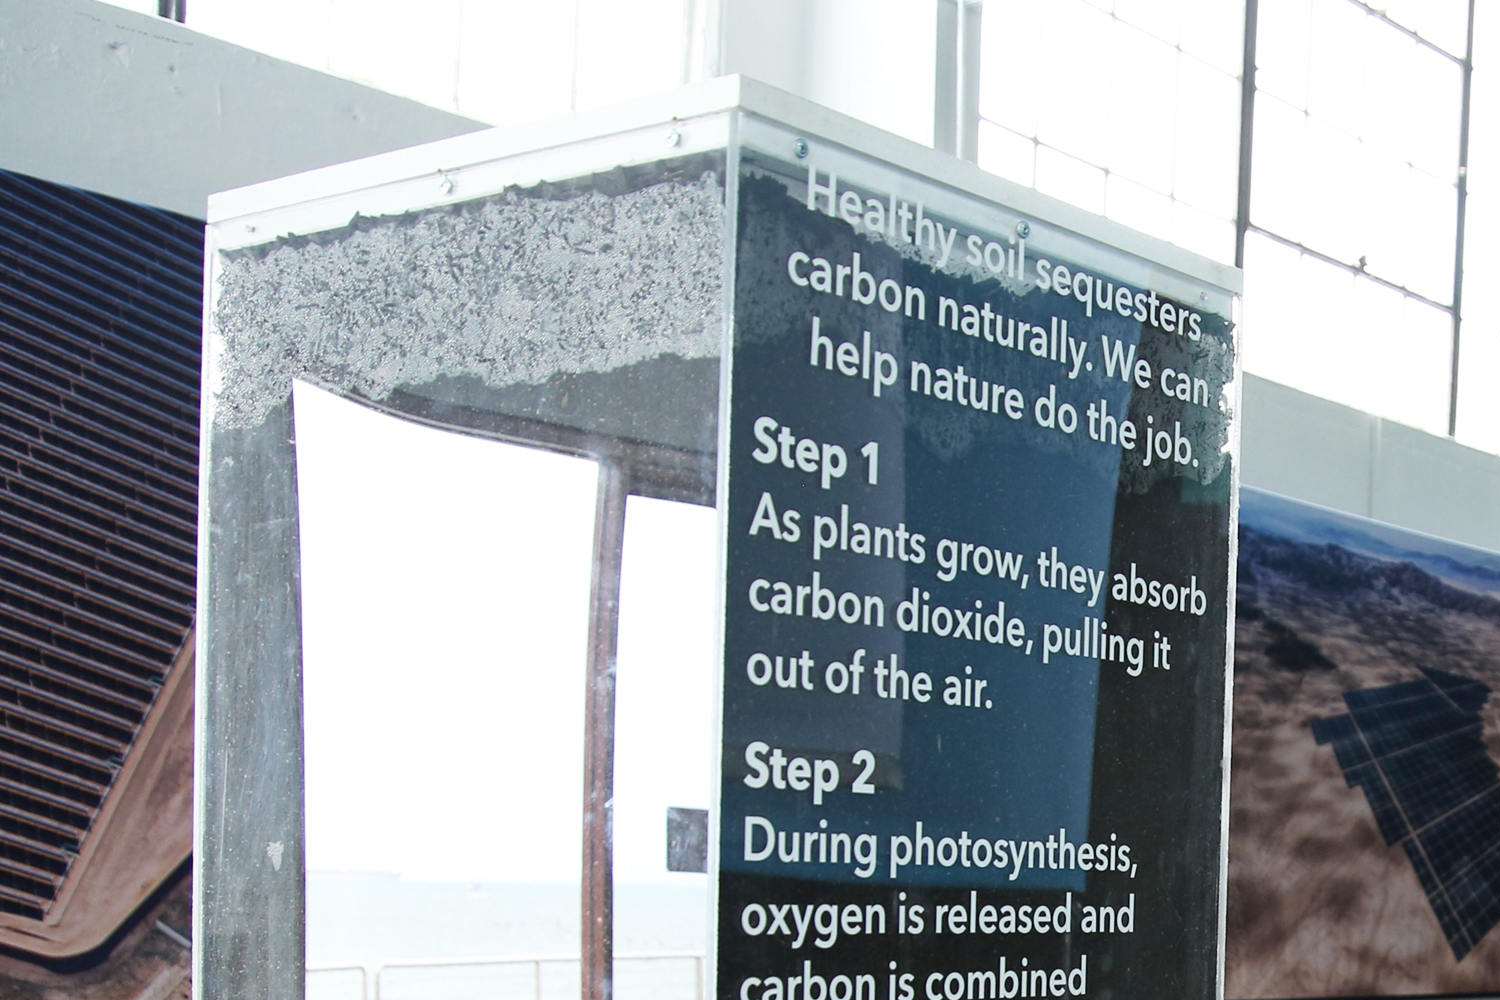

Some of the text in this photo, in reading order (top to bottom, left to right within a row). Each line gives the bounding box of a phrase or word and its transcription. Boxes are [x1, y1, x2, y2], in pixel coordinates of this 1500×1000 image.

[807, 164, 1202, 341] Healthy soil sequesters
[788, 250, 1210, 408] carbon naturally. We can
[809, 317, 1201, 468] help nature do the job.
[752, 415, 879, 489] Step 1
[749, 492, 1208, 616] As plants grow, they absorb
[748, 571, 1172, 677] carbon dioxide, pulling it
[746, 648, 993, 710] out of the air.
[743, 741, 876, 805] Step 2
[743, 815, 1138, 881] During photosynthesis,
[741, 891, 1136, 949] oxygen is released and
